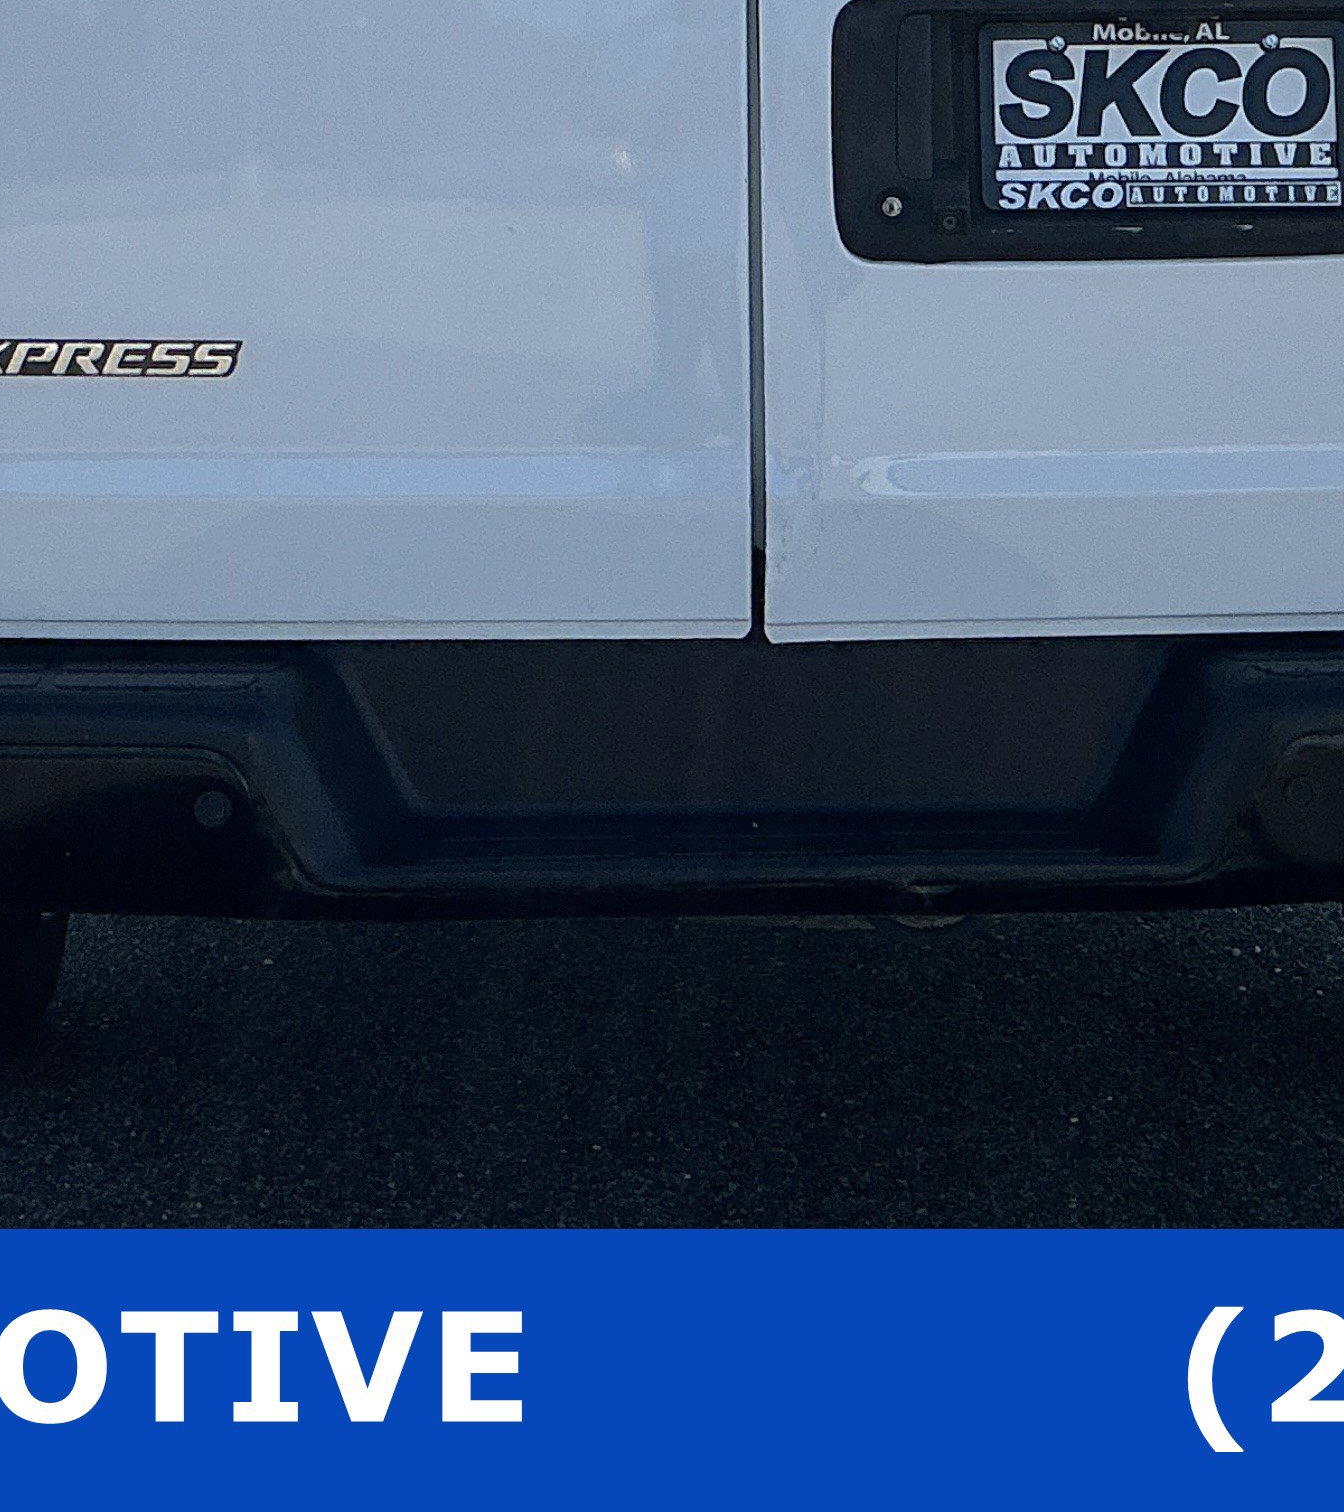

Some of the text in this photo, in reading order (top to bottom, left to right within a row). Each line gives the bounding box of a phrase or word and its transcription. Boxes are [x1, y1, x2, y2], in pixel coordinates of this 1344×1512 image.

[1195, 22, 1230, 40] AL
[999, 46, 1331, 138] SKCO
[998, 142, 1333, 168] AUTOMOTIVE
[998, 181, 1339, 210] SKCO AUTOMOTIVE
